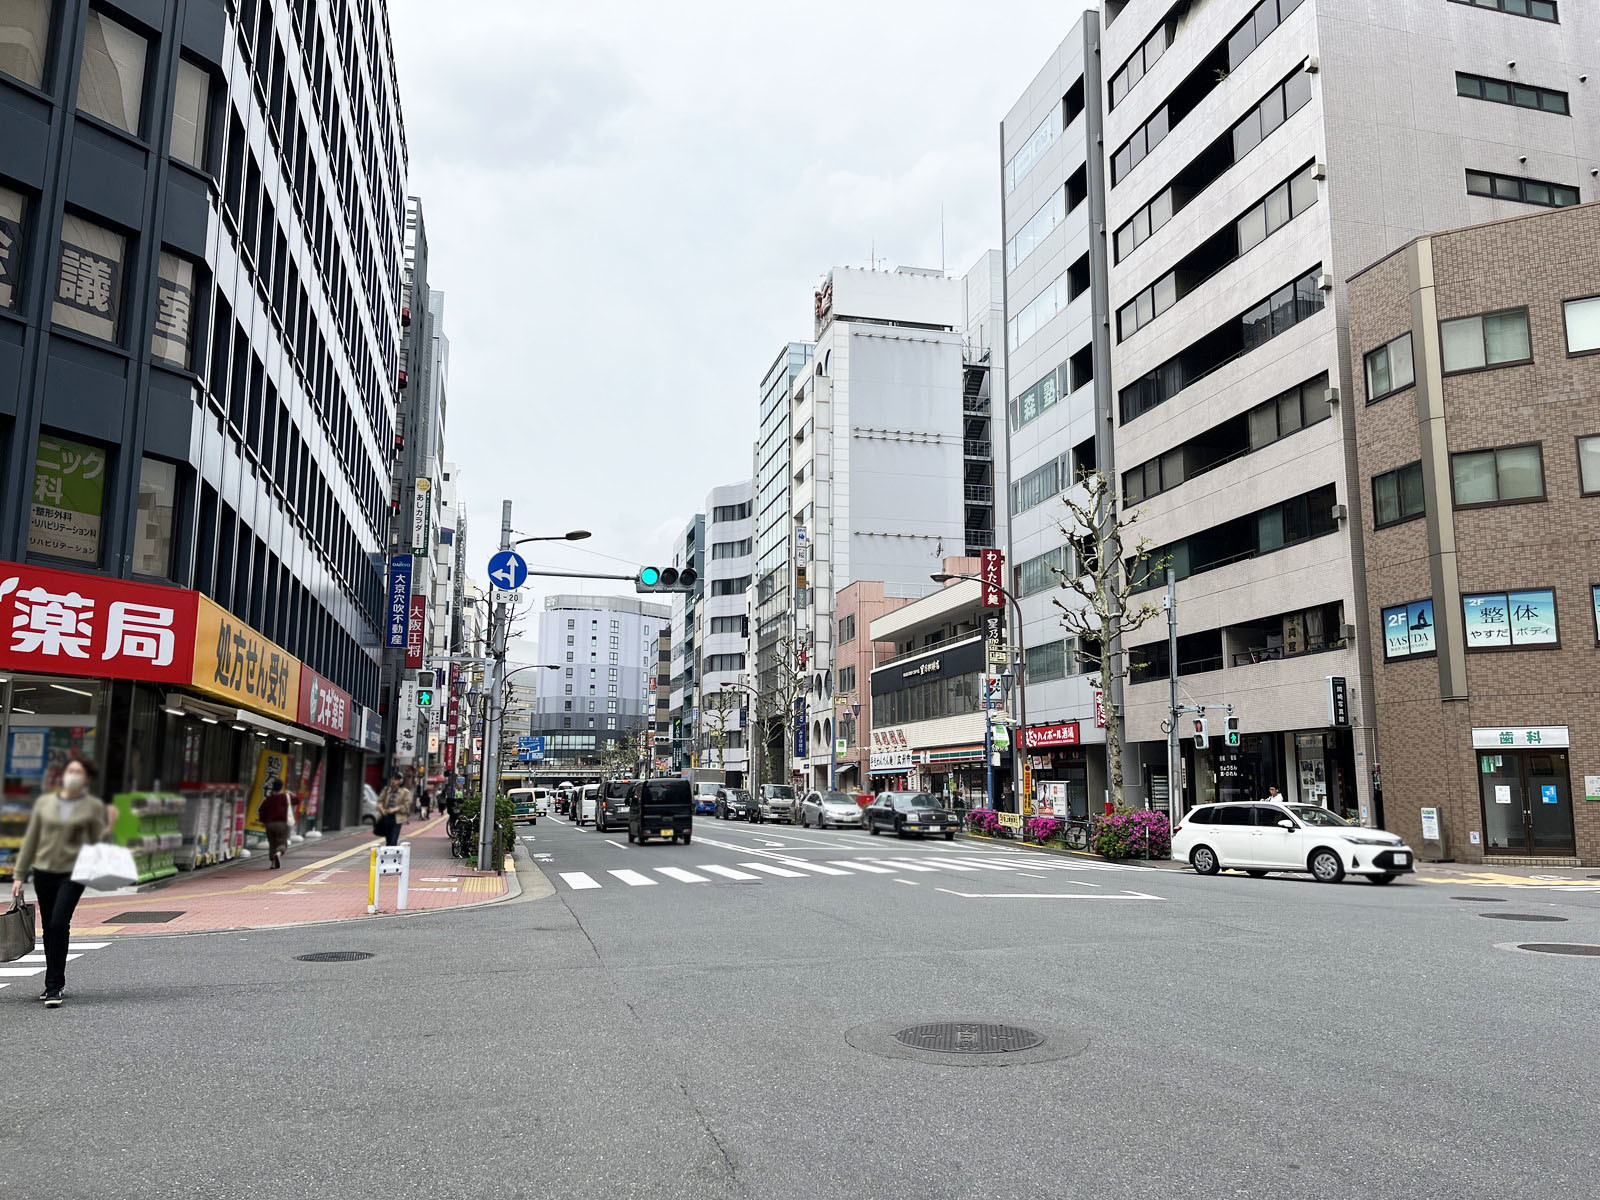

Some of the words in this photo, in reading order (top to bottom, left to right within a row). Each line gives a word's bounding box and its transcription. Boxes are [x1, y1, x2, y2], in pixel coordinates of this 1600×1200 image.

[1023, 377, 1056, 421] 森塾
[415, 493, 424, 532] あしカラダ
[414, 548, 425, 556] 4F
[986, 551, 1000, 606] わんたん麺
[0, 576, 176, 668] 薬局
[391, 573, 407, 647] 大京穴吹不動産
[1388, 612, 1406, 627] 2F
[1468, 598, 1486, 608] 2F
[1479, 604, 1540, 624] 整体
[408, 605, 424, 657] 大阪王将
[214, 618, 289, 710] 処方せん受付
[317, 691, 346, 733] スギ薬局
[1037, 727, 1075, 741] ハイボール酒場
[1499, 731, 1542, 745] 歯科
